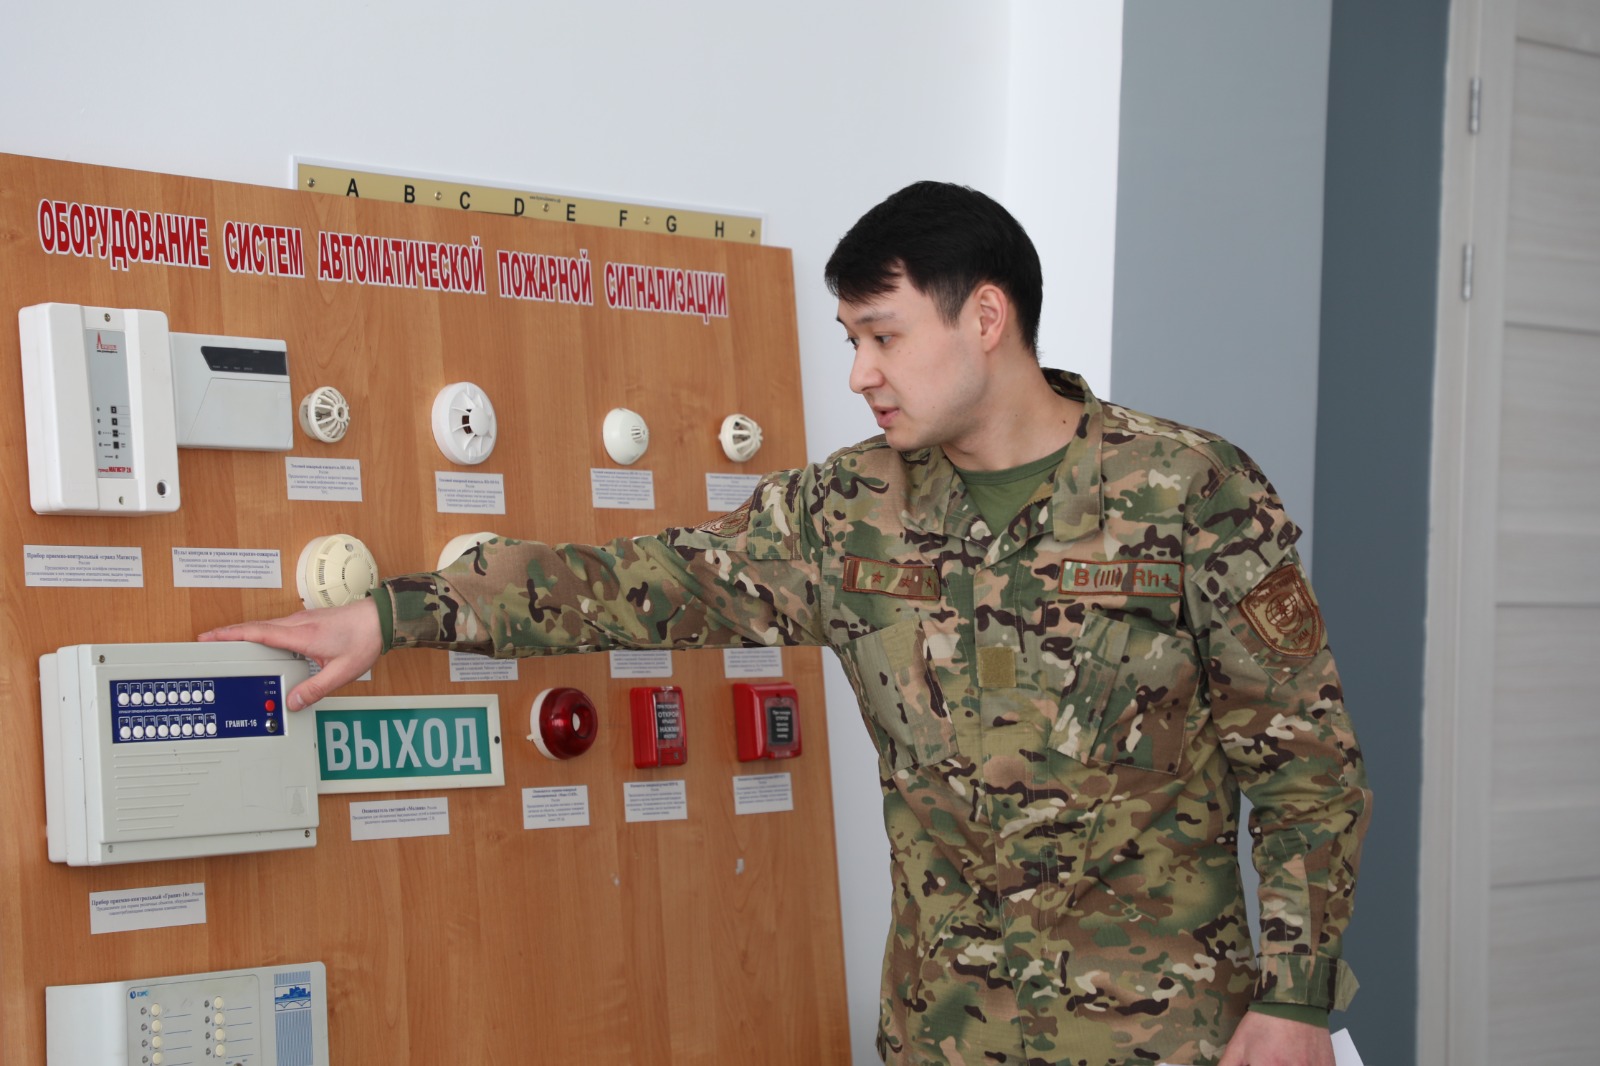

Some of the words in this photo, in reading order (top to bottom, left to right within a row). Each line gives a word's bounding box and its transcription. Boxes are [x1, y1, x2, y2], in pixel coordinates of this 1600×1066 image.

[346, 178, 359, 198] A
[404, 185, 416, 203] B
[459, 191, 471, 210] C
[514, 198, 525, 216] D
[566, 204, 576, 222] E
[619, 210, 628, 227] F
[666, 215, 677, 233] G
[715, 220, 725, 238] H
[38, 198, 210, 271] ОБОРУДОВАНИЕ
[223, 221, 305, 278] СИСТЕМ
[318, 231, 486, 294] АВТОМАТИЧЕСКОЙ
[497, 249, 593, 306] ПОЖАРНОЙ
[604, 262, 728, 324] СИГНАЛИЗАЦИИ
[1074, 568, 1090, 586] B
[1133, 568, 1172, 587] Rh+
[225, 719, 257, 728] ГРАНИТ-16
[324, 717, 481, 771] ВЫХОД
